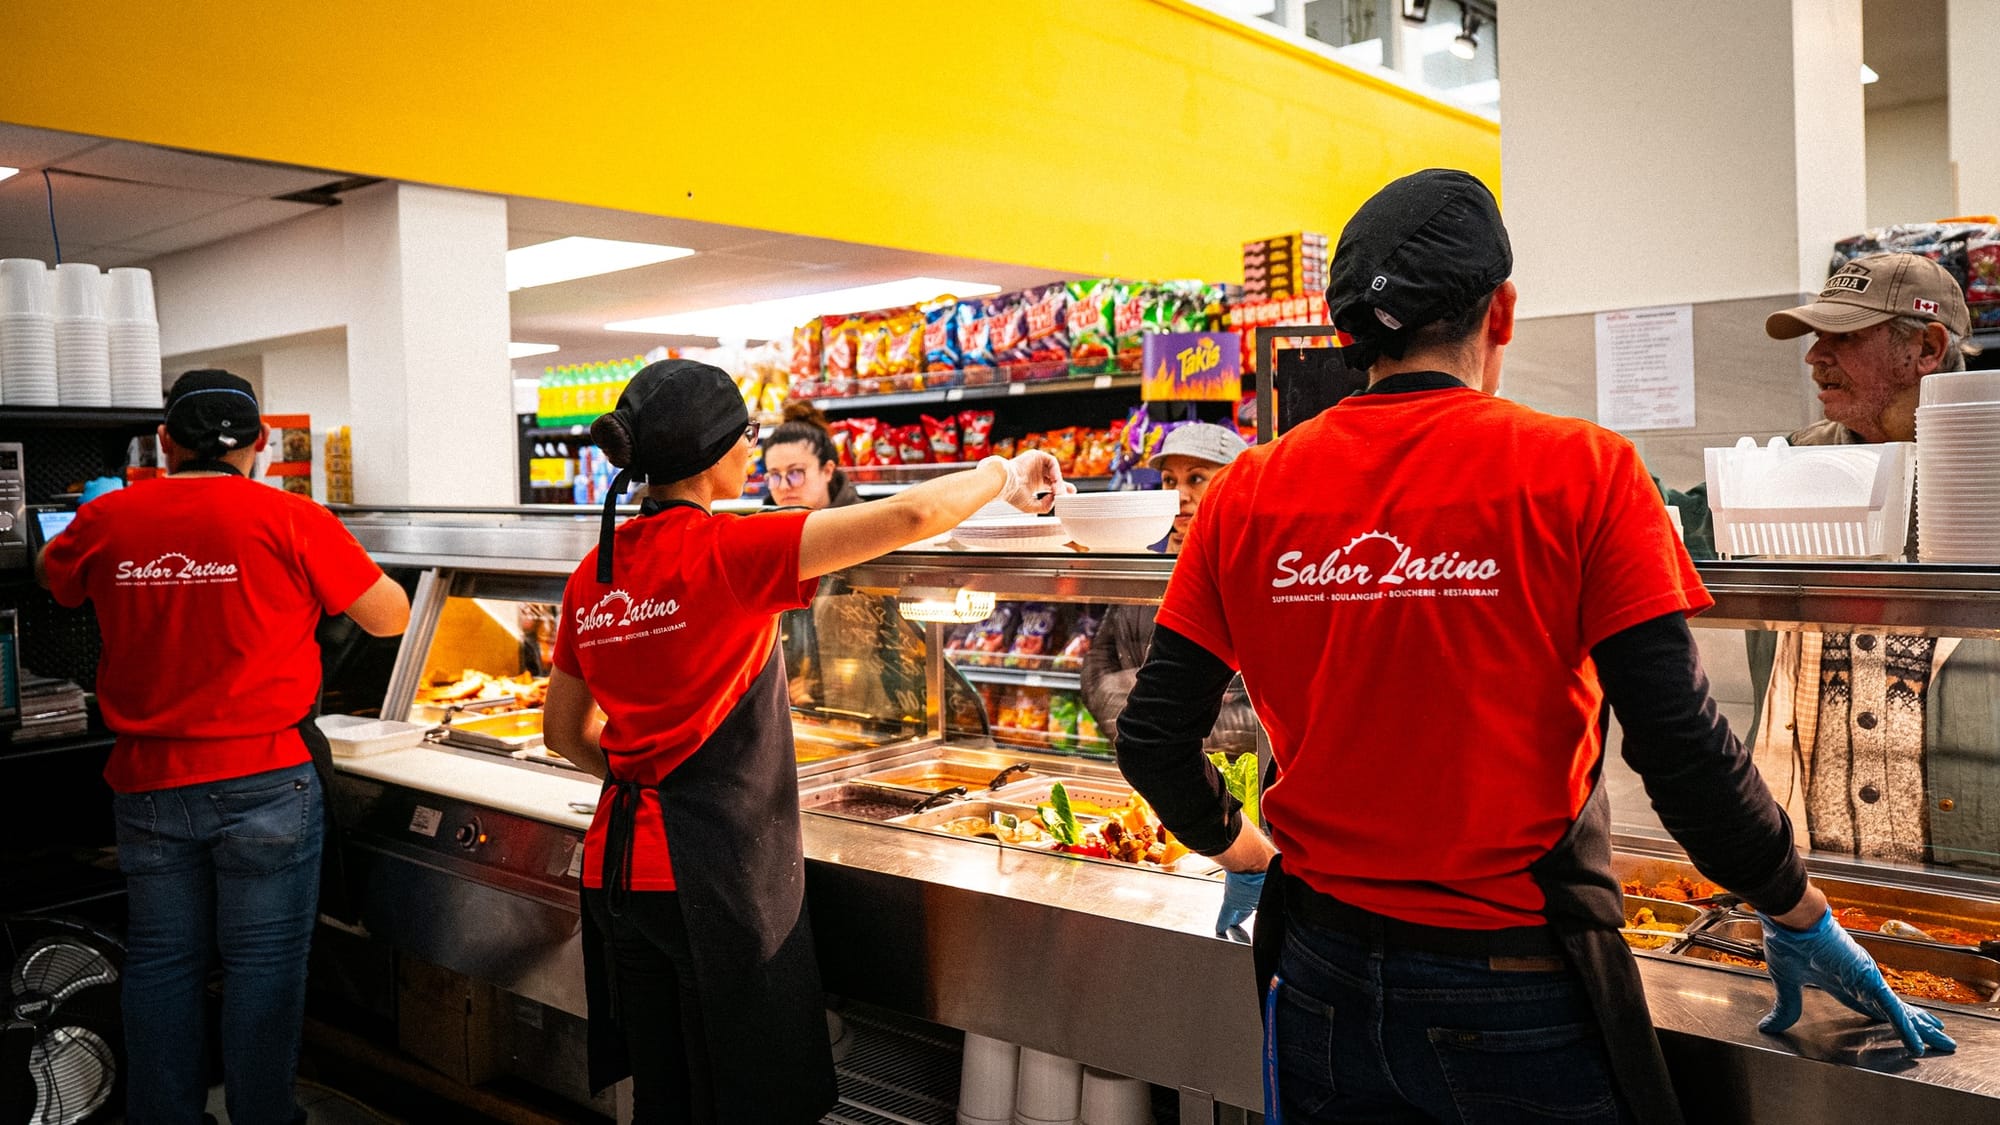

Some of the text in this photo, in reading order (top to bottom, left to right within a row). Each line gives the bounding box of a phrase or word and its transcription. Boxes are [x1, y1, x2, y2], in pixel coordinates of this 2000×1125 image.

[1176, 343, 1221, 382] Takis
[115, 560, 238, 580] Sabor Latino
[1271, 546, 1501, 588] Sabor Latino
[1272, 592, 1325, 603] SUPERMARCHÉ
[1388, 588, 1436, 598] BOUCHERIE
[1443, 588, 1500, 598] RESTAURANT
[575, 598, 680, 635] Sabor Latino
[652, 621, 687, 635] RESTAURANT
